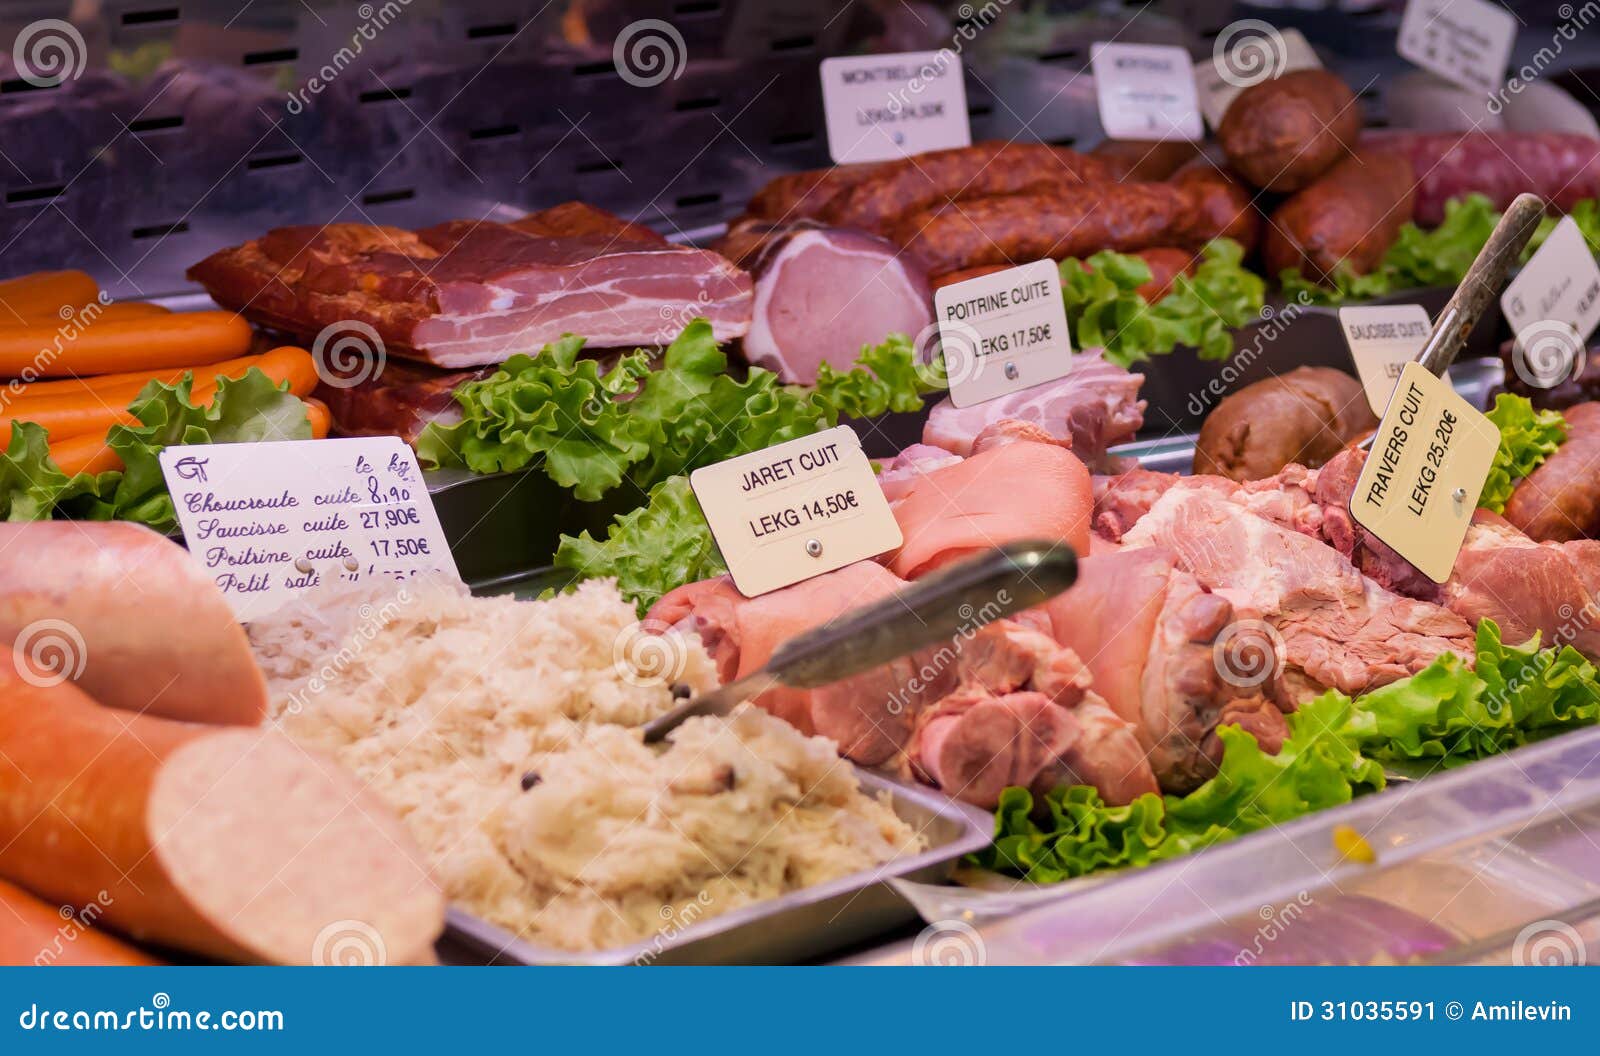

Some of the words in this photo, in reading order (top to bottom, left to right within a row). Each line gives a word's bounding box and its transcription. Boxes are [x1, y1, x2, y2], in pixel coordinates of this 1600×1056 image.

[946, 291, 1009, 322] POITRINE
[1011, 280, 1050, 305] CUITE
[973, 334, 1009, 358] LEKG
[1012, 324, 1052, 348] 17,50€
[1366, 426, 1408, 508] TRAVERS
[1399, 382, 1425, 426] CUIT
[1407, 465, 1437, 517] LEKG
[1427, 408, 1458, 468] 25,20€
[356, 455, 373, 474] le
[742, 458, 798, 492] JARET
[799, 444, 840, 471] CUIT
[184, 490, 299, 513] Choucroute
[314, 488, 362, 505] cuite
[367, 476, 411, 506] 8,90
[196, 518, 289, 539] Saucisse
[303, 513, 349, 532] cuite
[360, 507, 421, 530] 27,90€
[750, 509, 800, 538] LEKG
[802, 490, 859, 521] 14,50€
[206, 546, 292, 567] Poitrine
[306, 540, 353, 560] cuite
[370, 538, 431, 559] 17,50€
[215, 572, 271, 593] Petit
